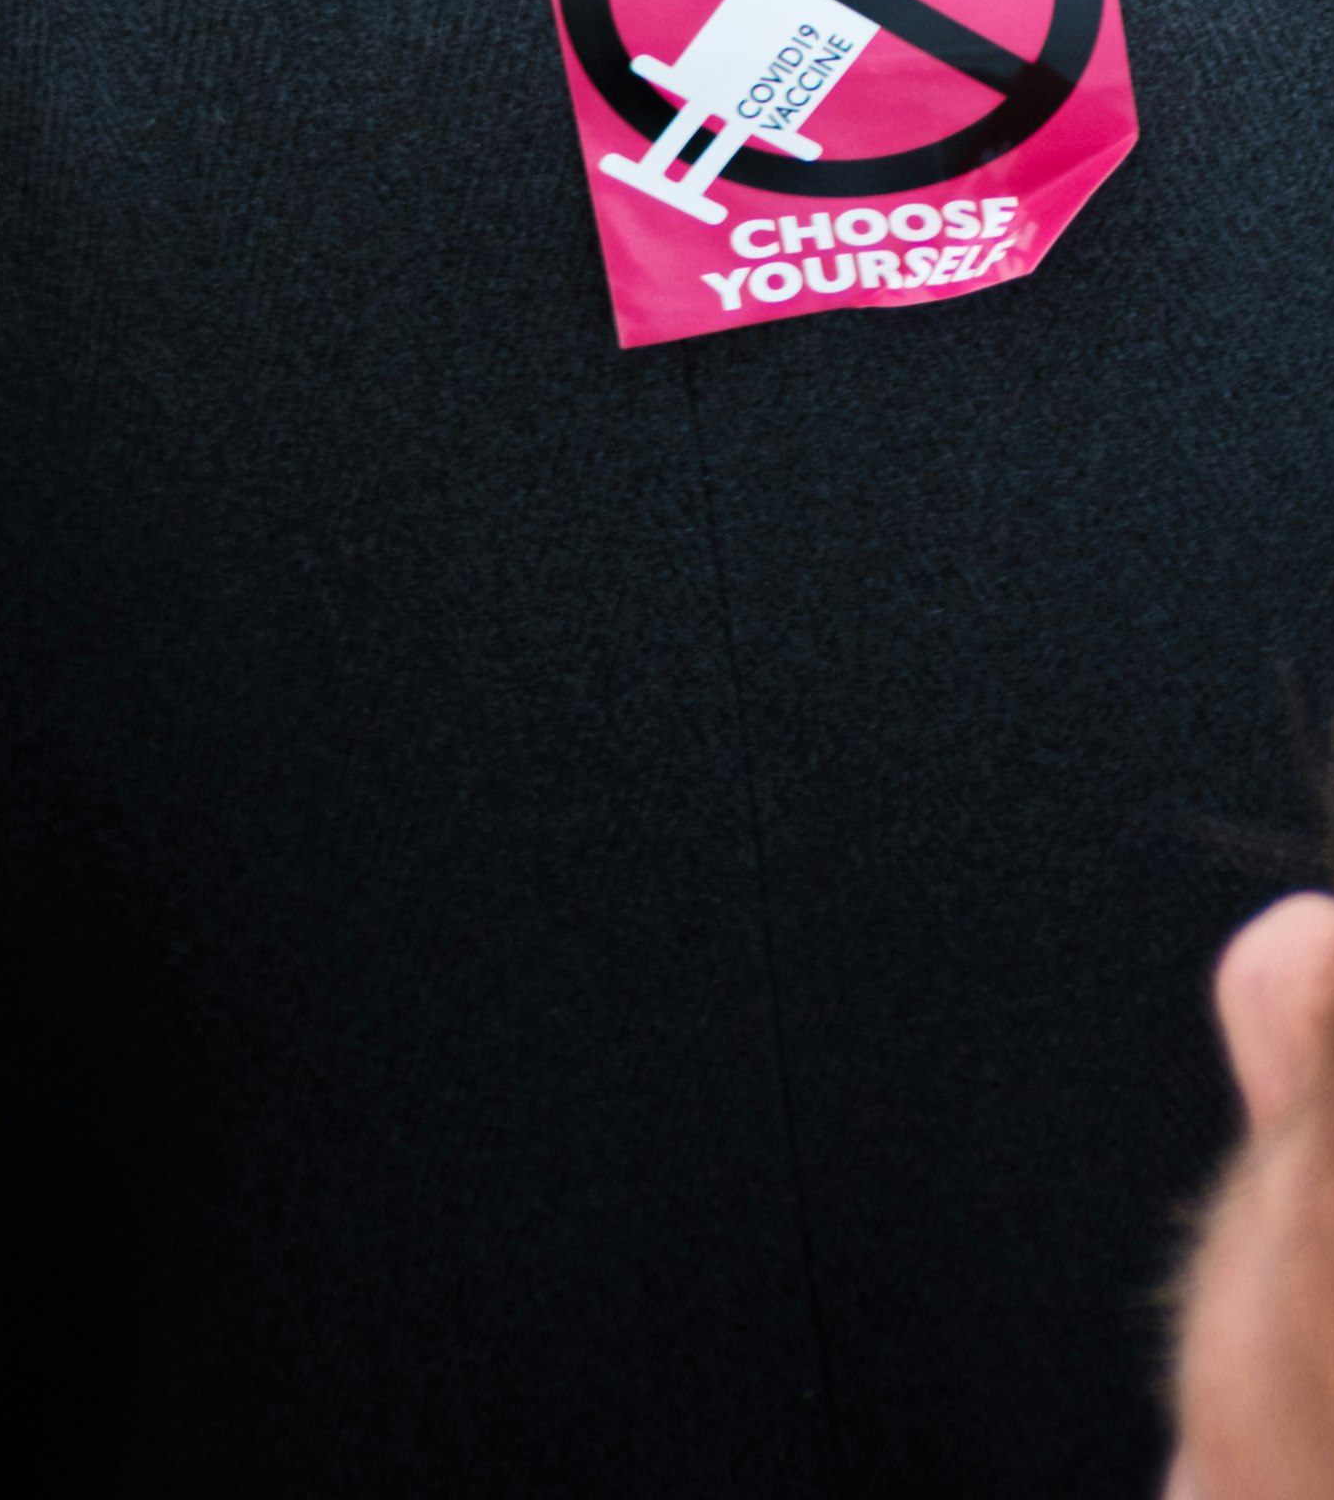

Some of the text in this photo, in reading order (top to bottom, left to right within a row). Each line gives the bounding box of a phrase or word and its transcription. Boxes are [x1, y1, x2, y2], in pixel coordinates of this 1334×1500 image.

[736, 23, 819, 119] COVID19
[759, 33, 854, 131] VACCINE
[729, 197, 1019, 259] CHOOSE
[700, 238, 1017, 312] YOURSELF
